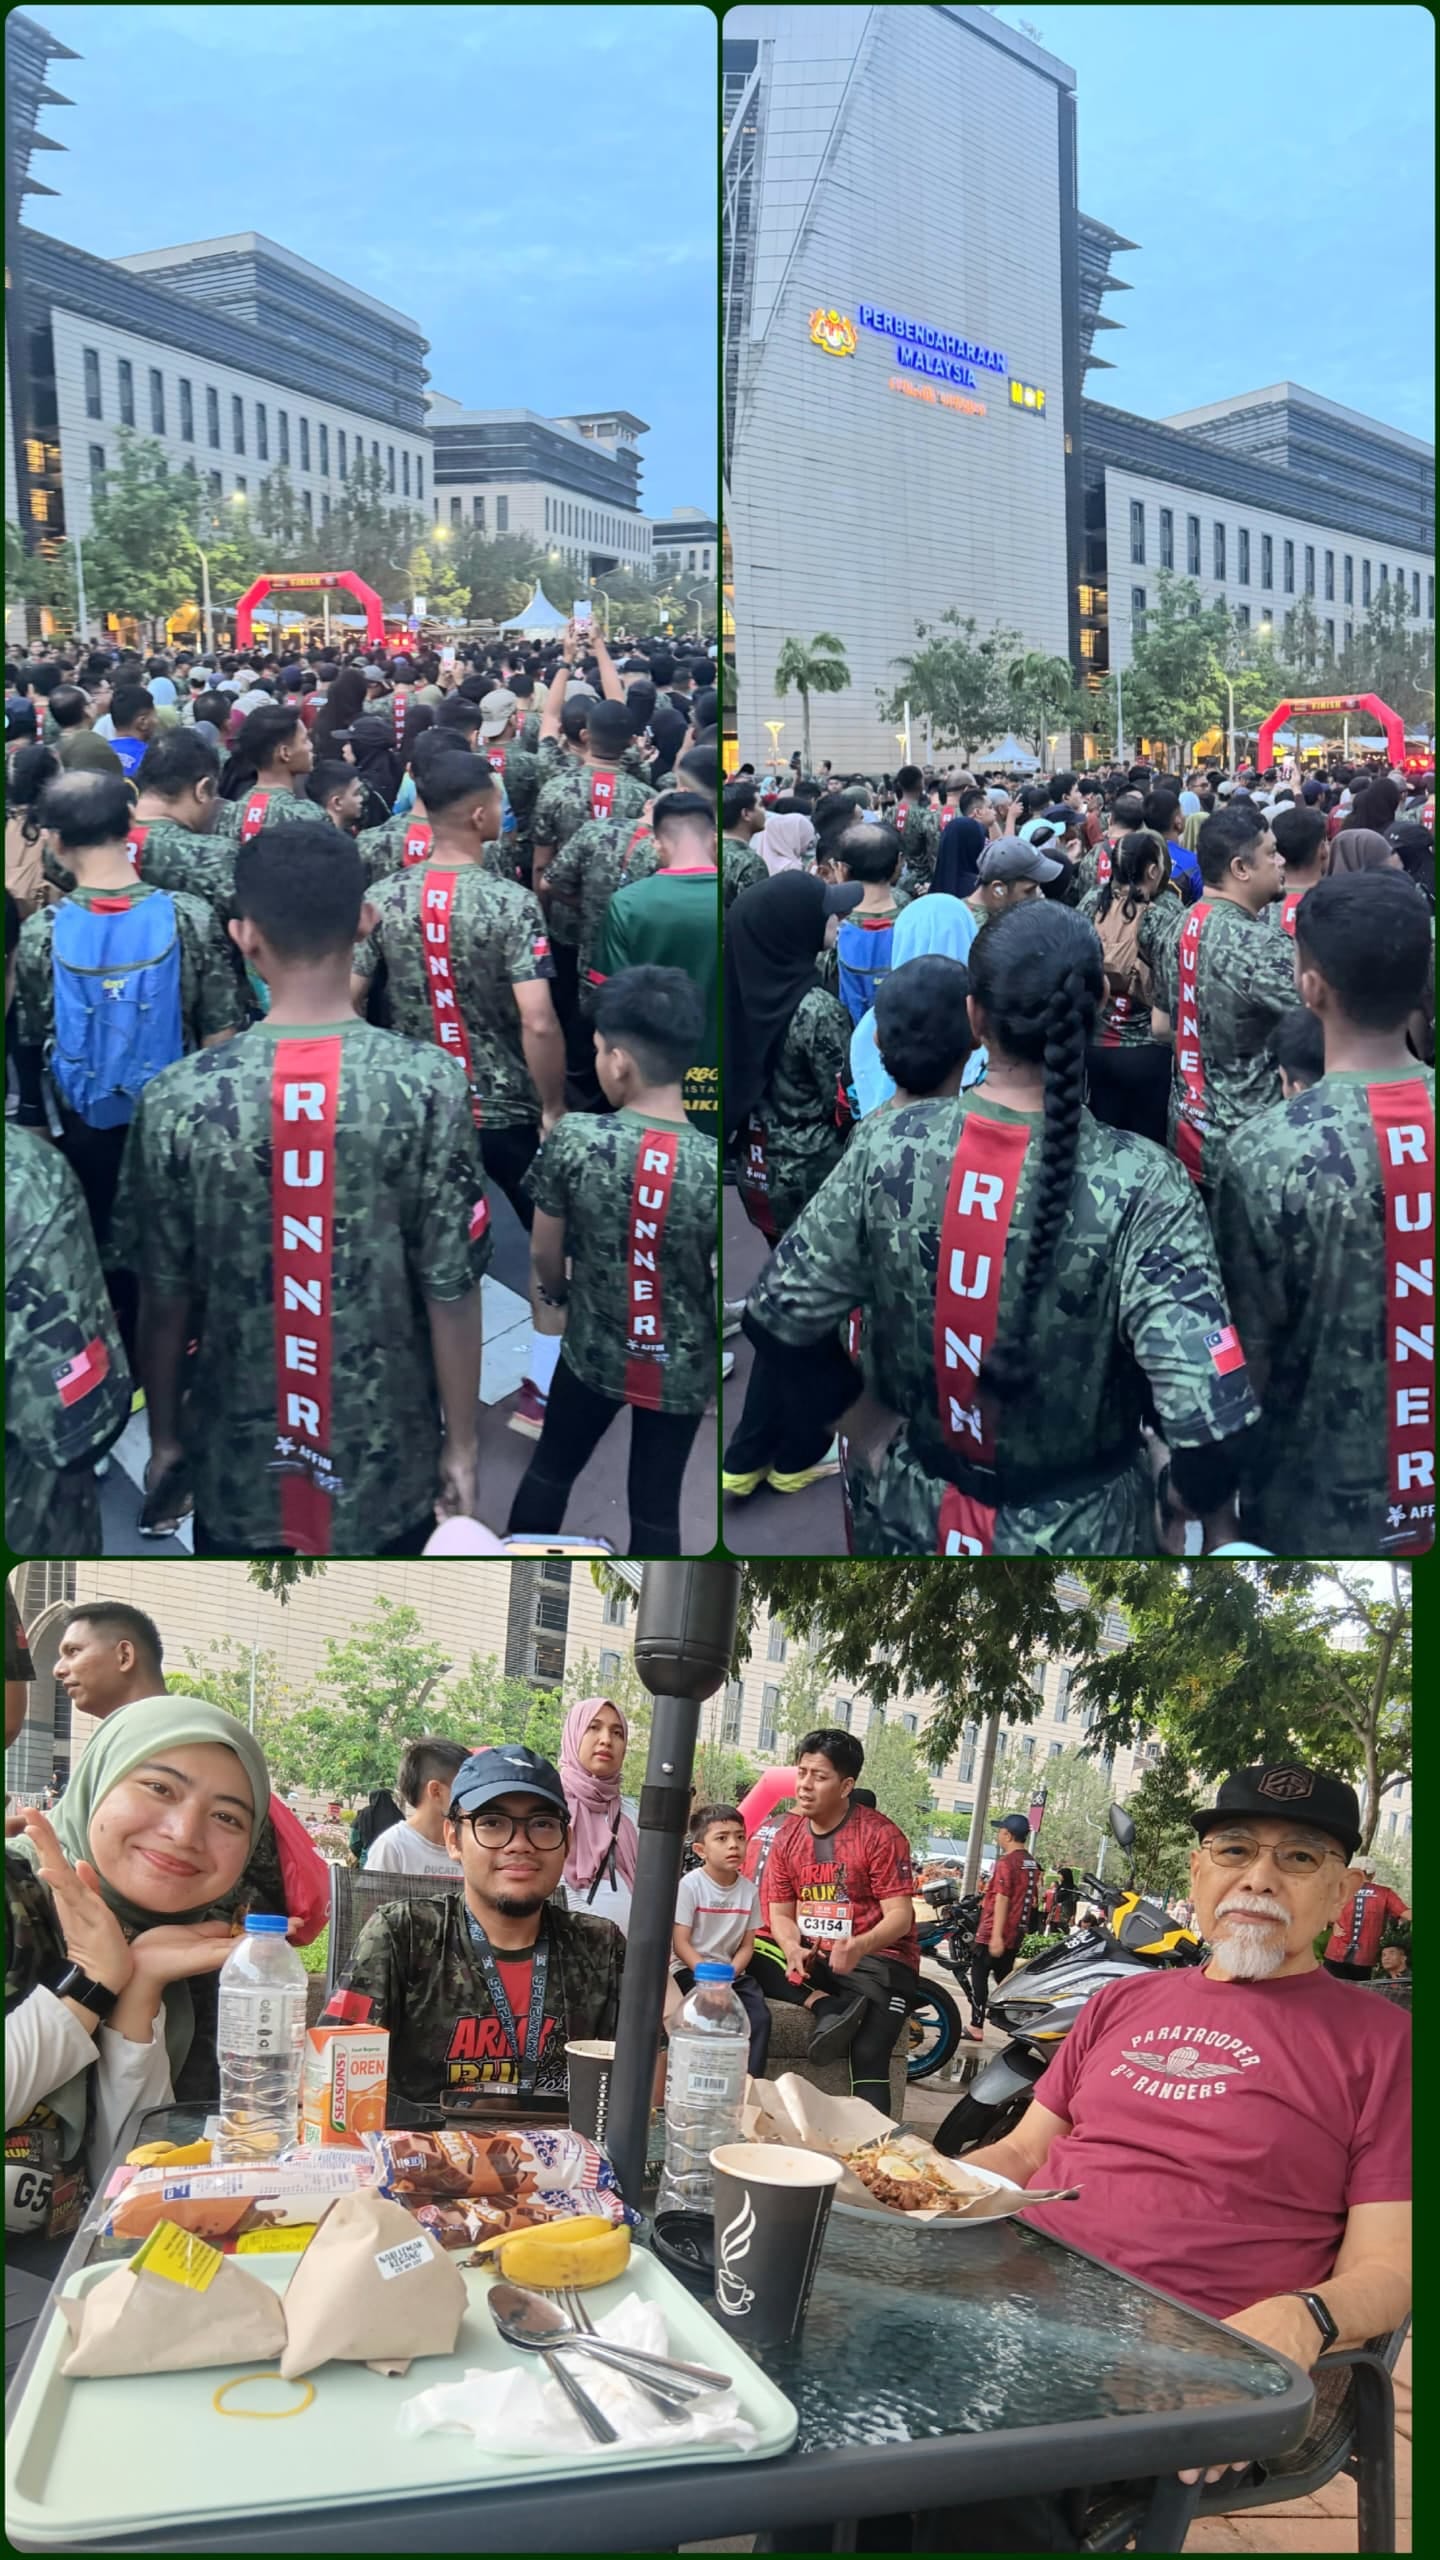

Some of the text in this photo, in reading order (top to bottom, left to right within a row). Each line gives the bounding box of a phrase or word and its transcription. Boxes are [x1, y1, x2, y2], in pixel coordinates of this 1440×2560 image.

[860, 305, 1007, 374] PERBENDAHARAAN
[897, 347, 977, 390] MALAYSIA
[282, 1081, 327, 1437] RUNNER
[632, 1148, 670, 1336] RUNNER
[1386, 1124, 1435, 1490] RUNNER
[800, 1863, 839, 1886] ARMY
[801, 1885, 837, 1901] RUN
[803, 1918, 843, 1932] C3154
[350, 2060, 385, 2076] OREN
[1130, 2025, 1261, 2068] PARATROOPER
[334, 2060, 346, 2120] SEASONS
[450, 2061, 519, 2084] RU
[1132, 2075, 1227, 2100] RANGERS
